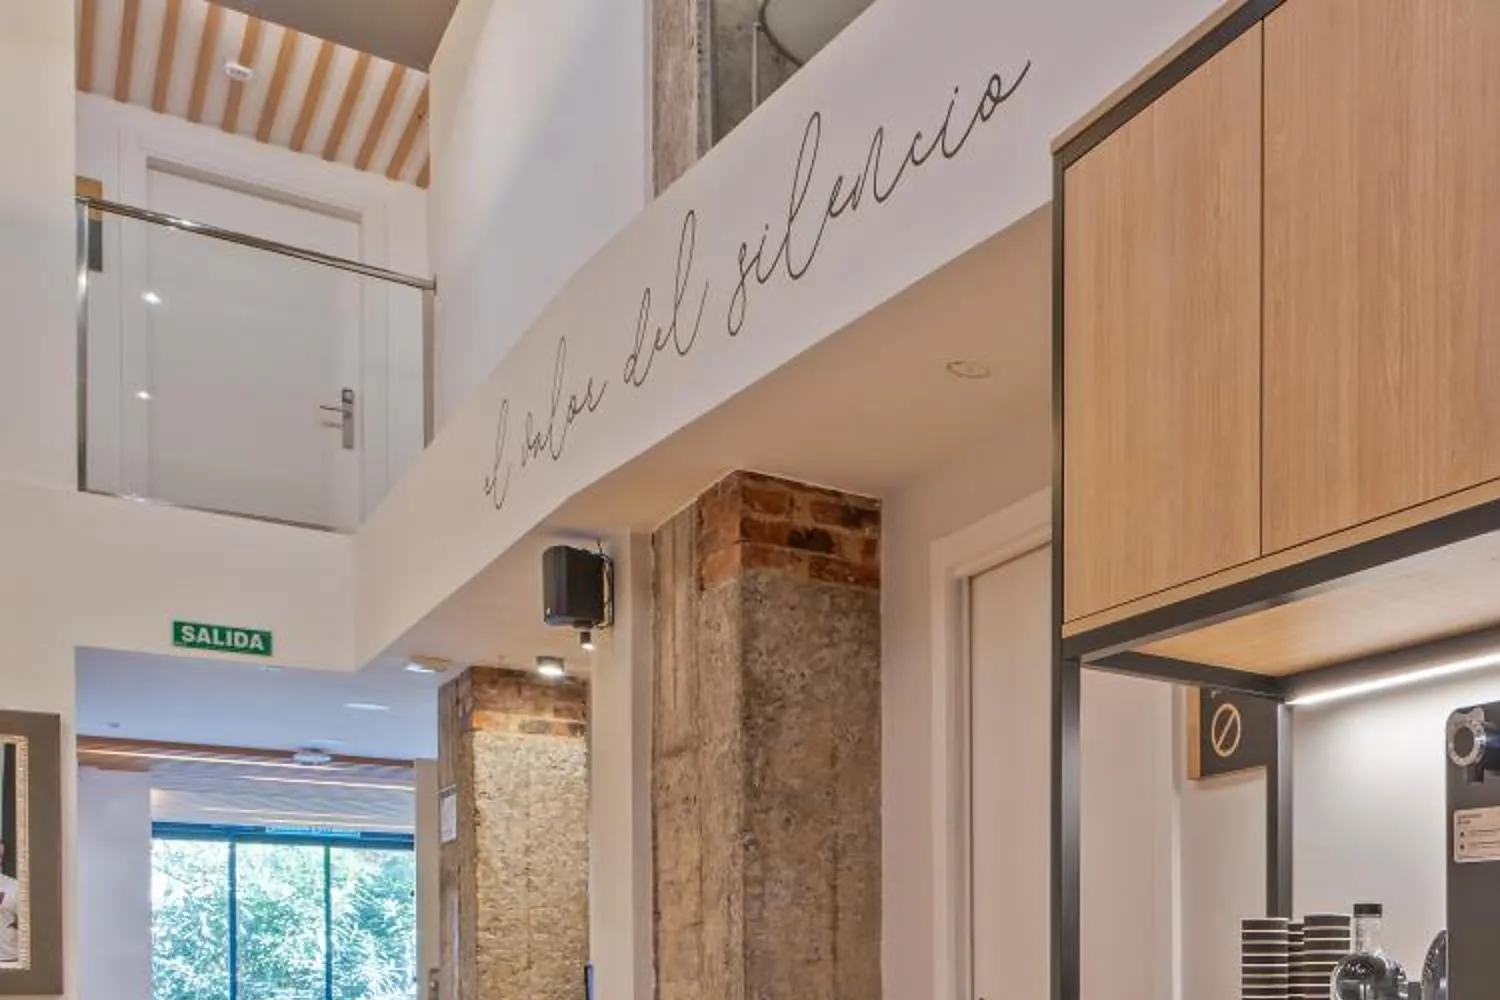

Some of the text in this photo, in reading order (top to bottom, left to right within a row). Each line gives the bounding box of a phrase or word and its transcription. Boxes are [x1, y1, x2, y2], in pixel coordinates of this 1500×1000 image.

[521, 335, 608, 466] valor
[623, 209, 708, 387] del
[727, 60, 1031, 336] silencio
[181, 625, 265, 651] SALIDA
